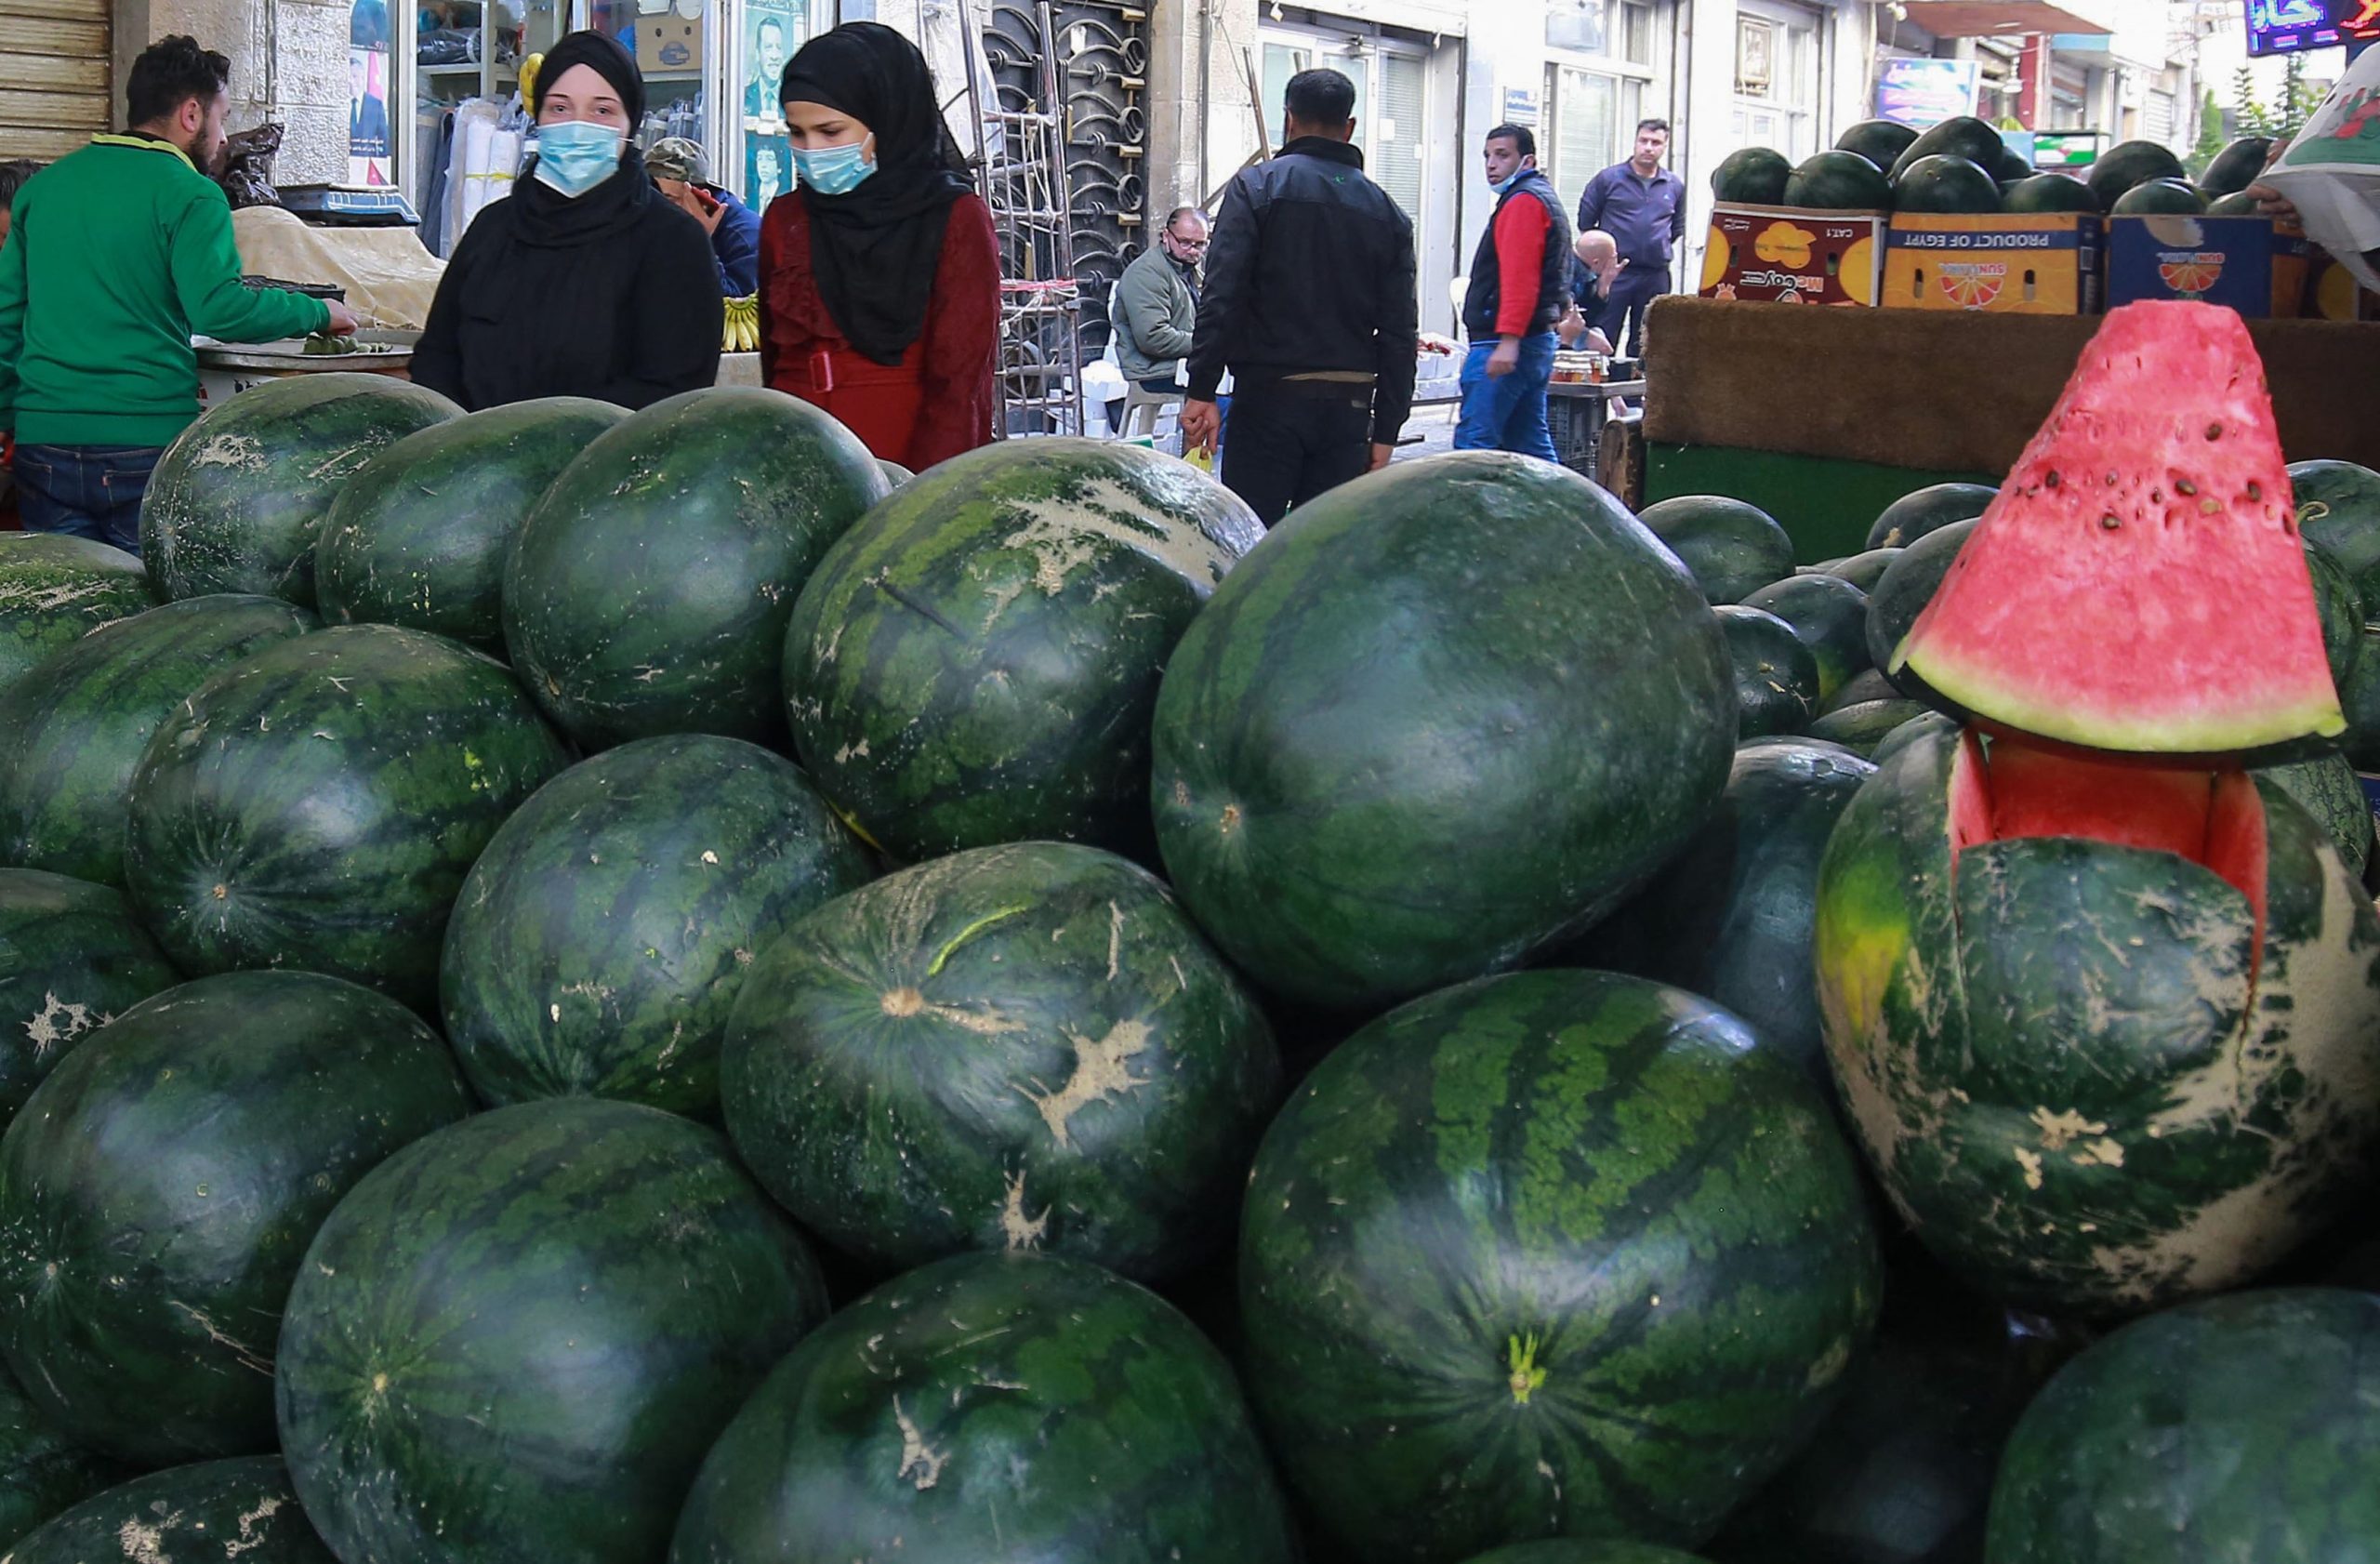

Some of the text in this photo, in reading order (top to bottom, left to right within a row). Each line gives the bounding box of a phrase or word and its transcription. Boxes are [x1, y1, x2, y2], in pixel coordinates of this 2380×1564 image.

[1826, 228, 1853, 238] CAT.1
[1904, 234, 2049, 247] PRODUCT OF EGYPT
